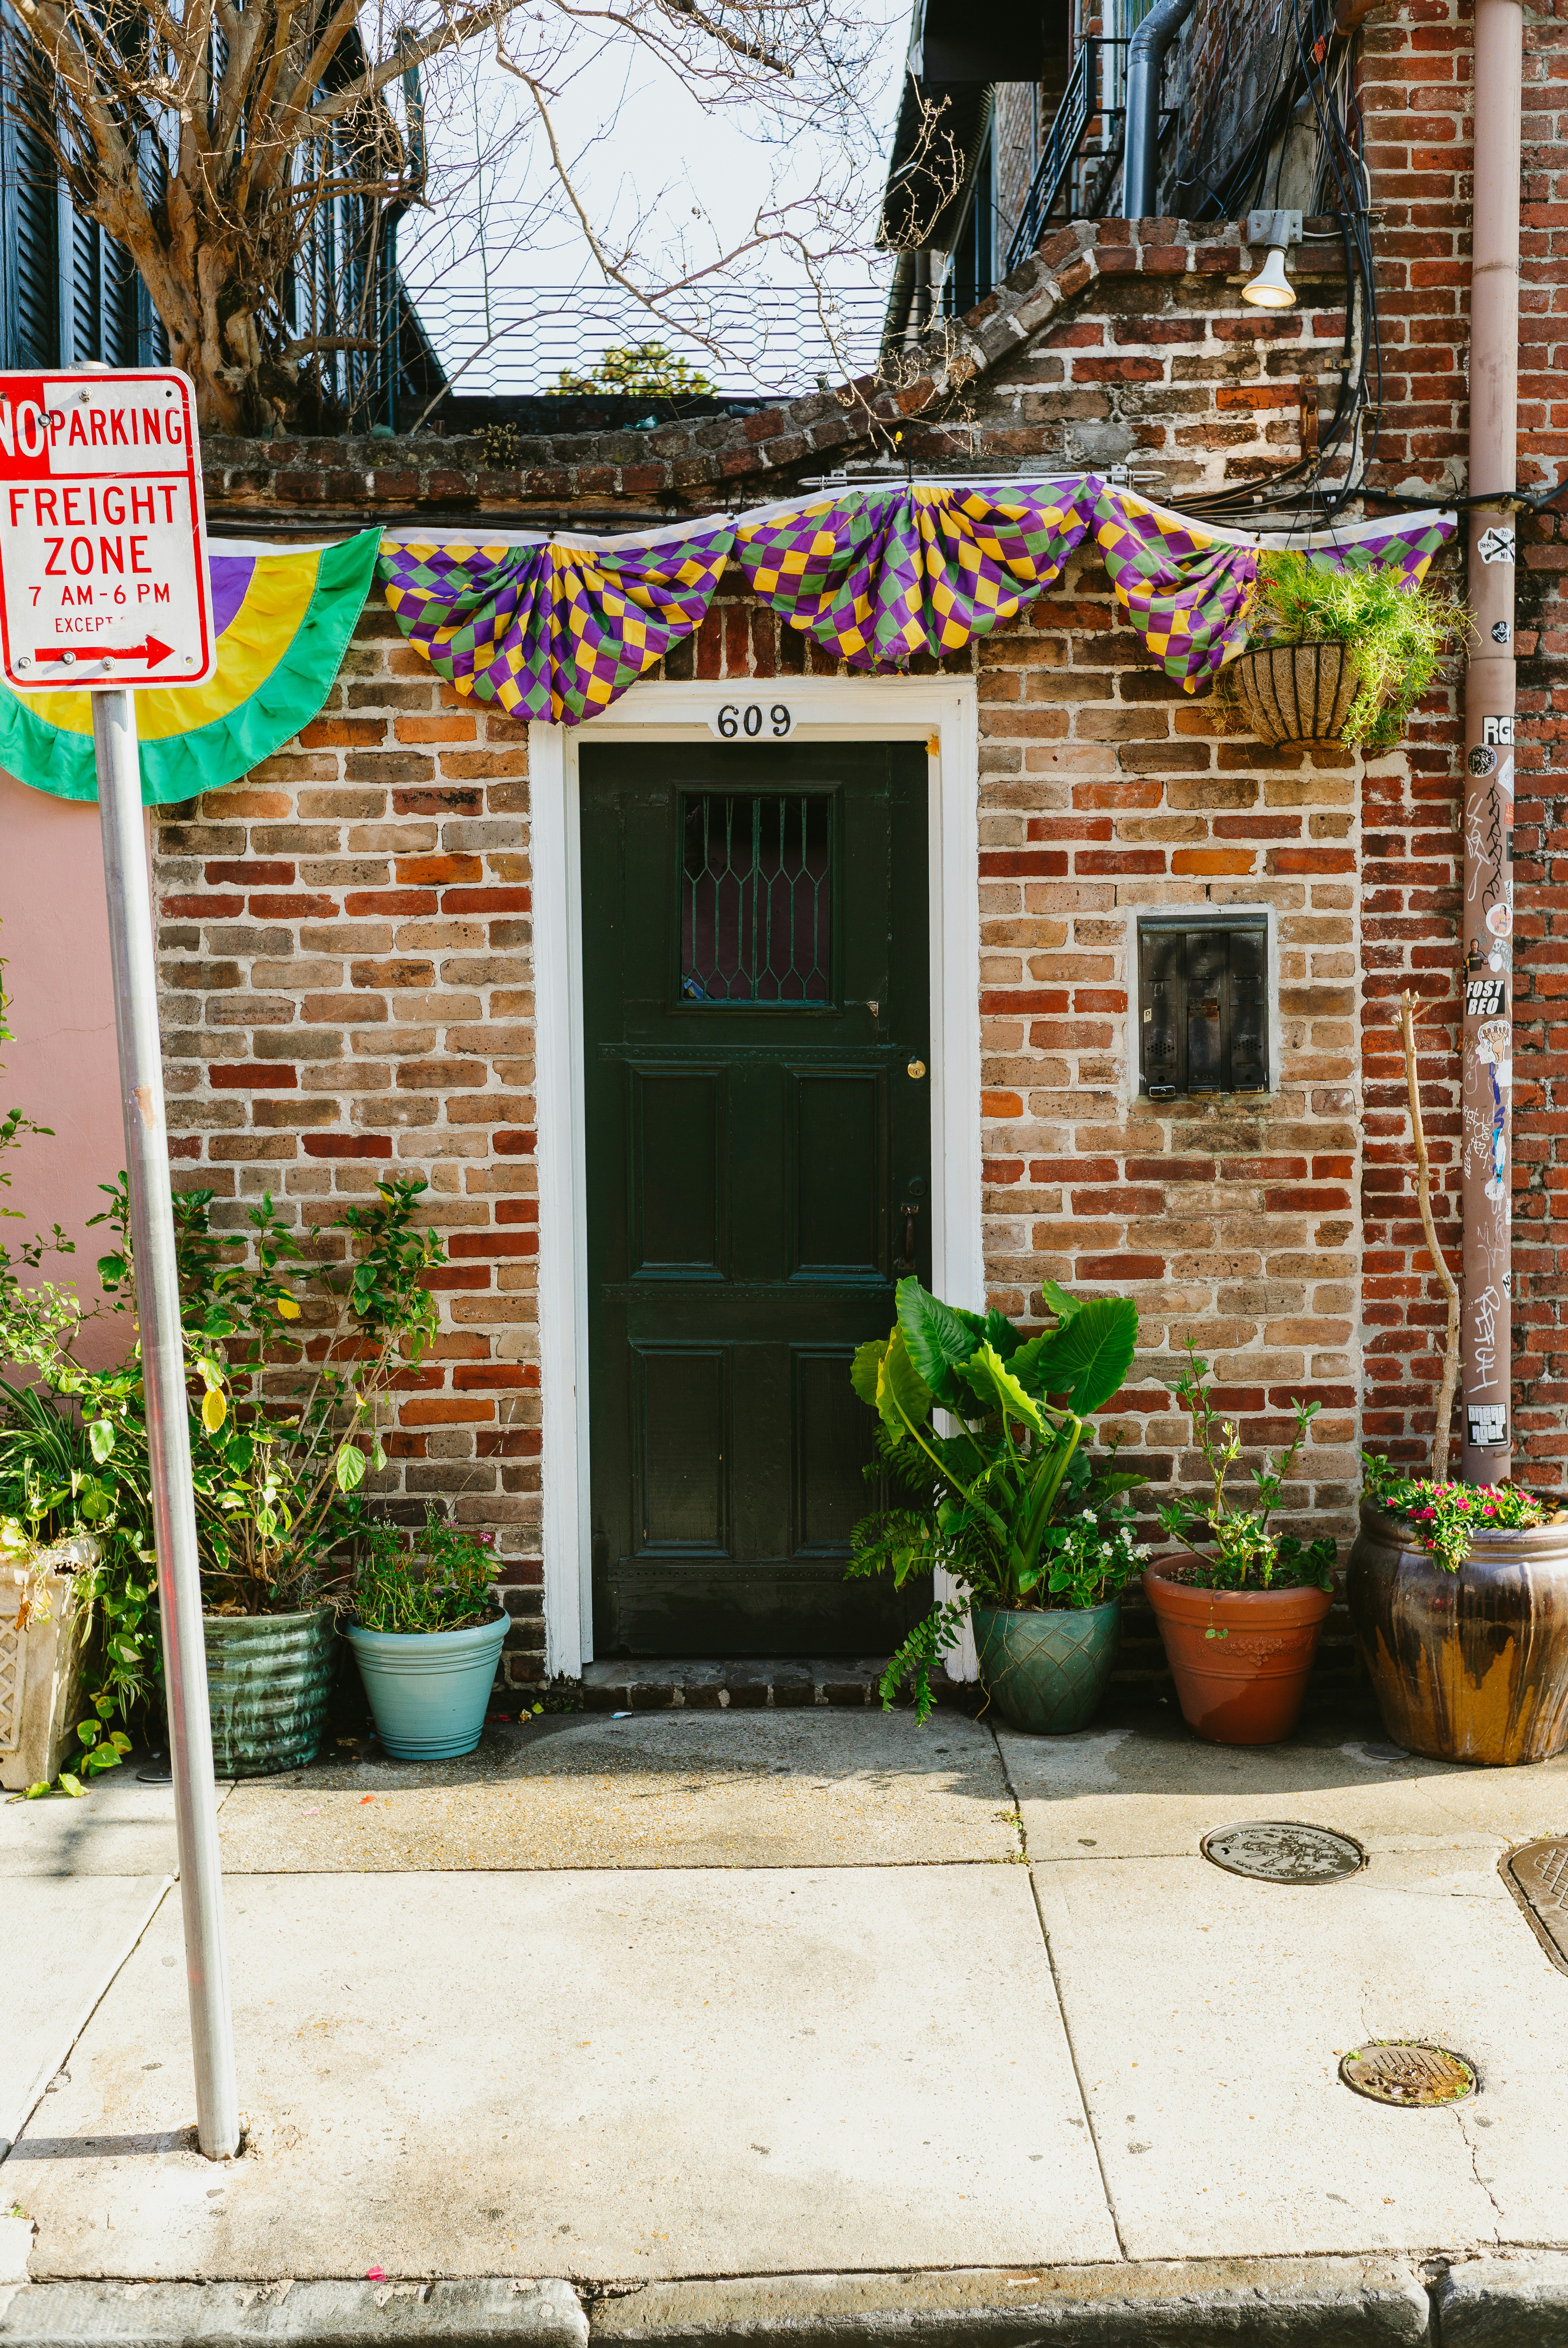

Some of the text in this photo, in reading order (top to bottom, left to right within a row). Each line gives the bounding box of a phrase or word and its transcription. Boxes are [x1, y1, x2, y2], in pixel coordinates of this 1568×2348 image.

[0, 400, 182, 457] NO PARKING
[9, 486, 177, 527] FREIGHT
[44, 536, 152, 576] ZONE
[29, 587, 41, 606] 7
[137, 583, 170, 603] PM
[718, 704, 791, 738] 609
[1466, 980, 1504, 998] FOST
[1467, 998, 1499, 1015] BEO
